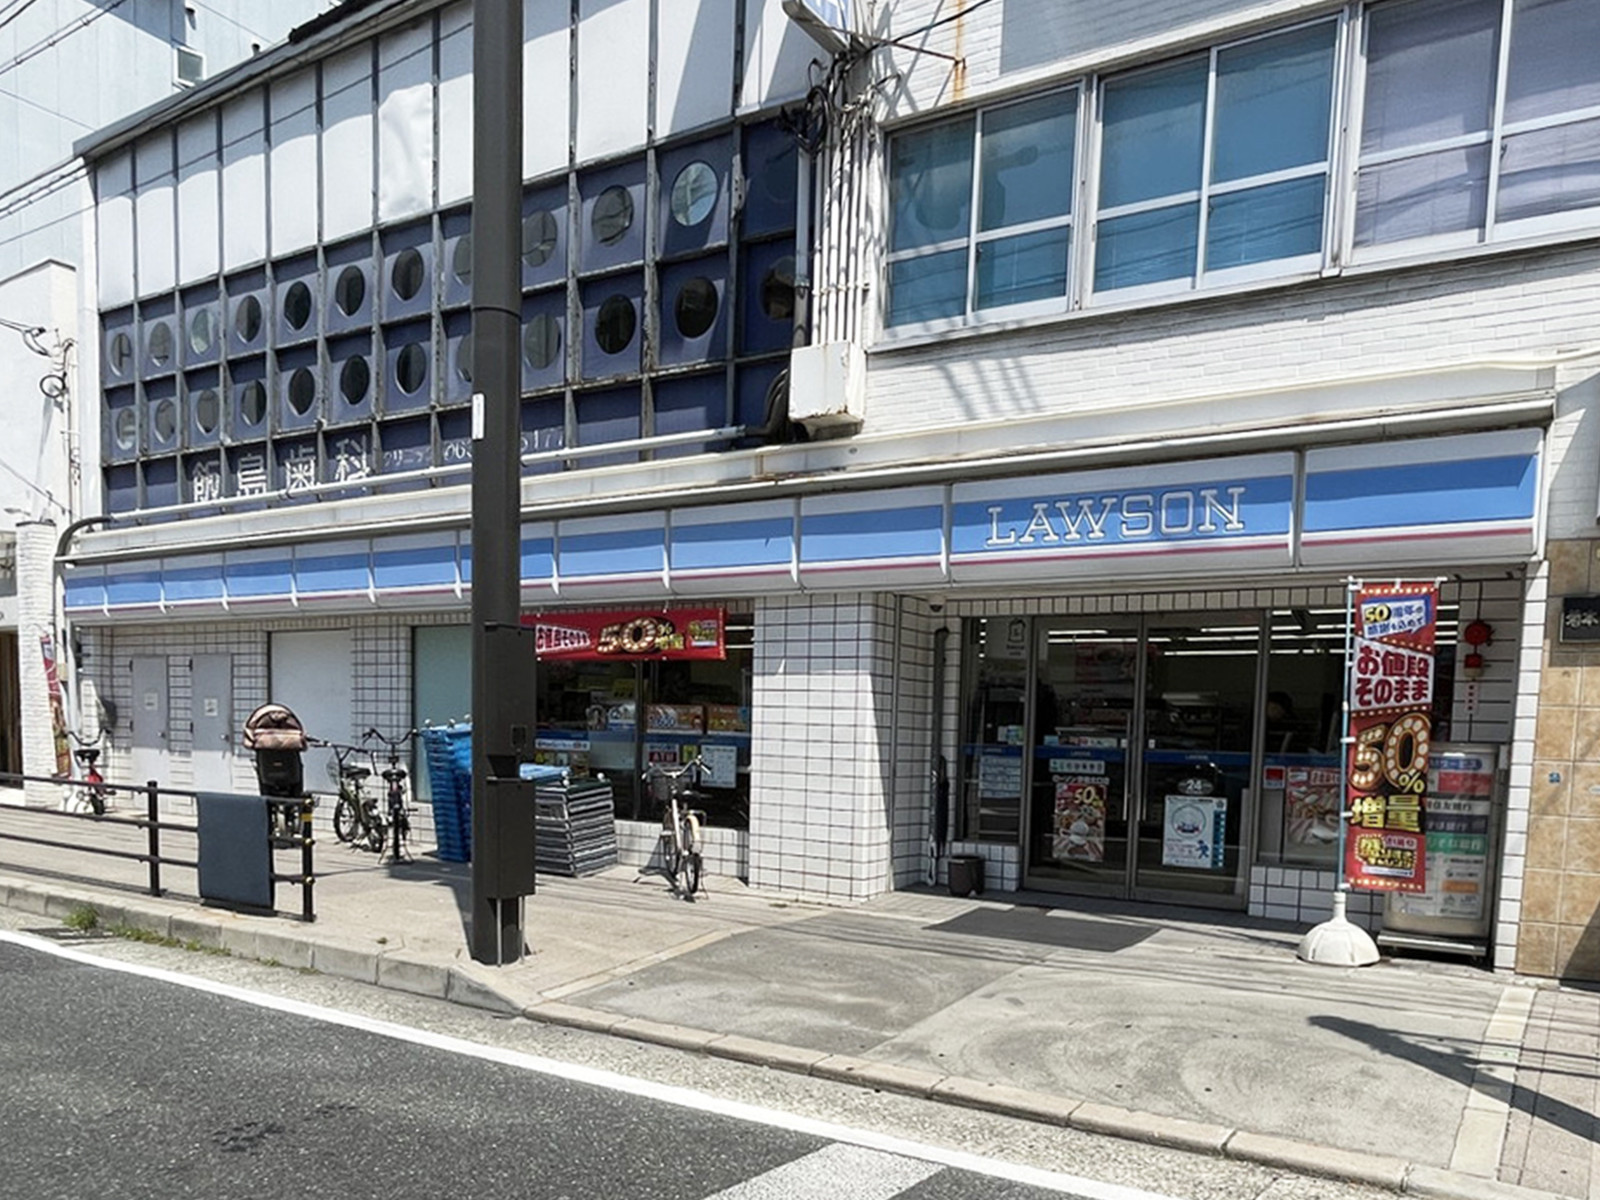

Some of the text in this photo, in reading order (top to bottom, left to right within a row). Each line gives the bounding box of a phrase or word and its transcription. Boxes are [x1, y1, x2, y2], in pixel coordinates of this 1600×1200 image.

[987, 487, 1246, 546] LAWSON
[1357, 645, 1429, 679] お値段
[1355, 677, 1428, 707] そのまま
[1350, 794, 1421, 832] 増量
